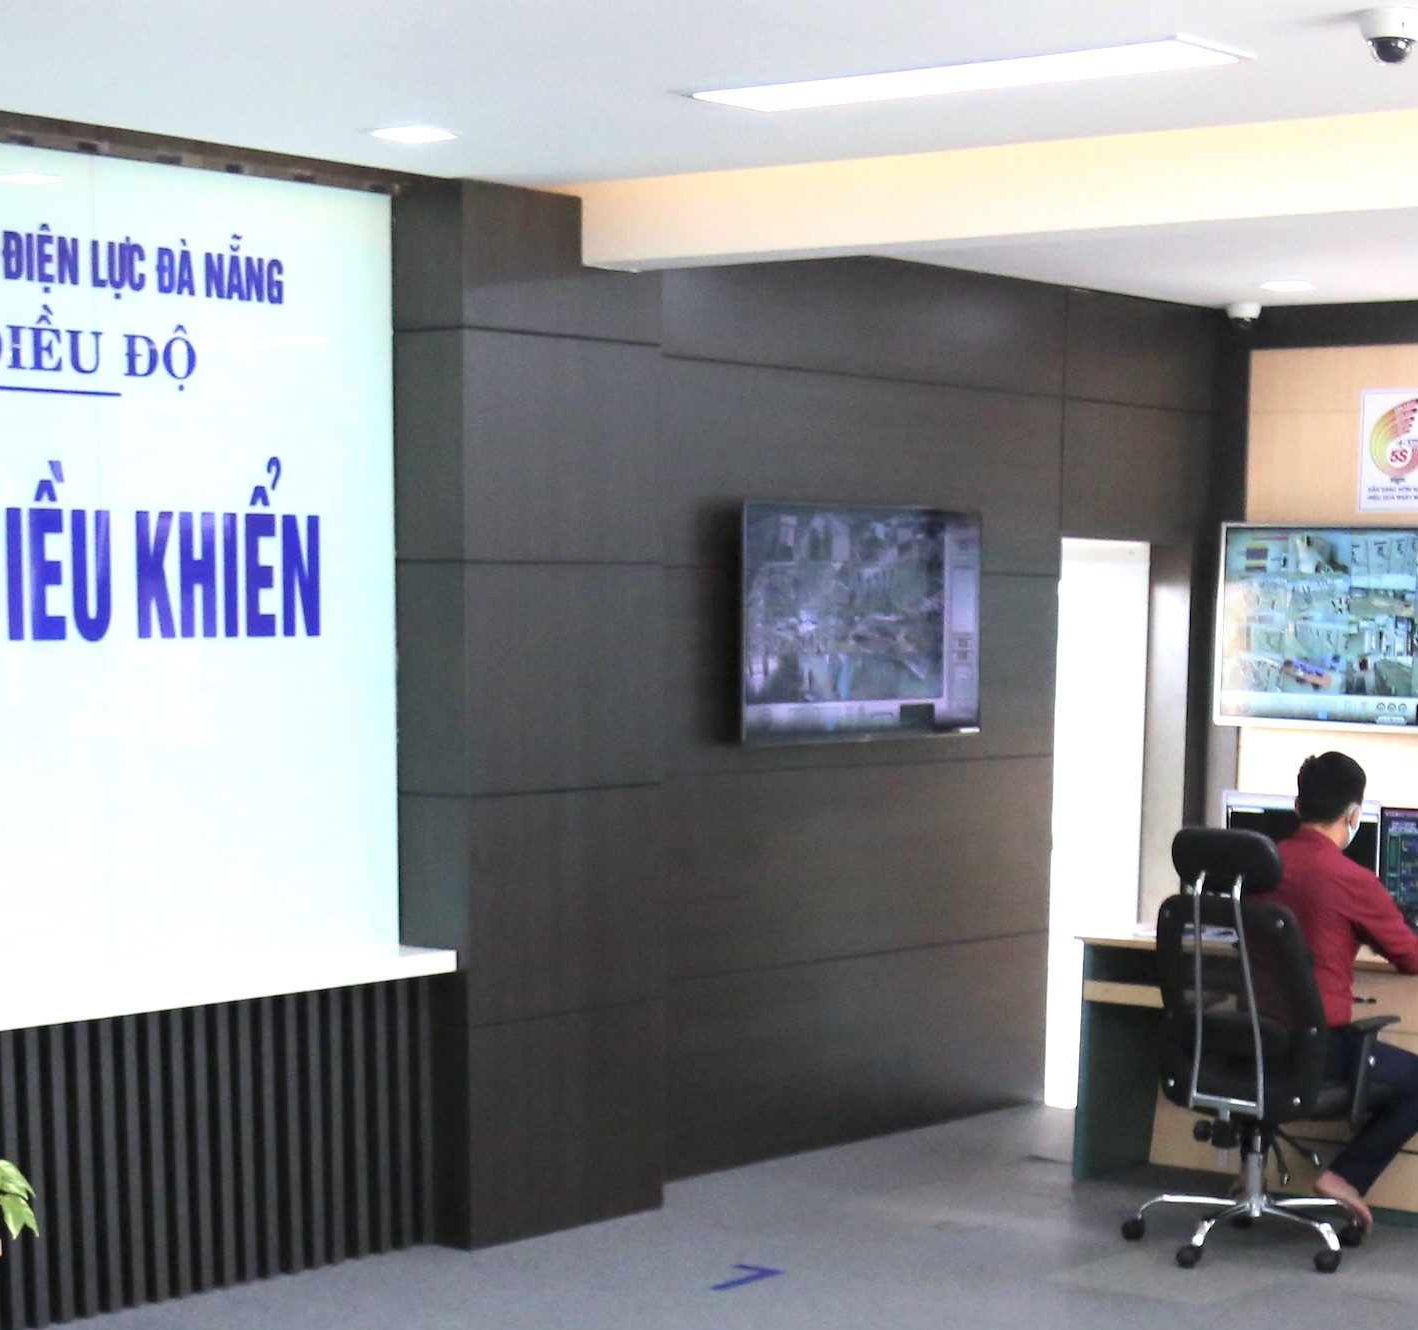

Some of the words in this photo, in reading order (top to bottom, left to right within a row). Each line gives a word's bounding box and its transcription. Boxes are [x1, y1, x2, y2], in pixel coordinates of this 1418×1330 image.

[2, 223, 79, 293] ĐIỆN
[90, 236, 146, 299] LỰC
[156, 238, 195, 296] ĐÀ
[205, 234, 283, 304] NẴNG
[123, 324, 196, 391] ĐỘ
[1390, 449, 1408, 462] 5S
[135, 456, 321, 639] KHIỂN
